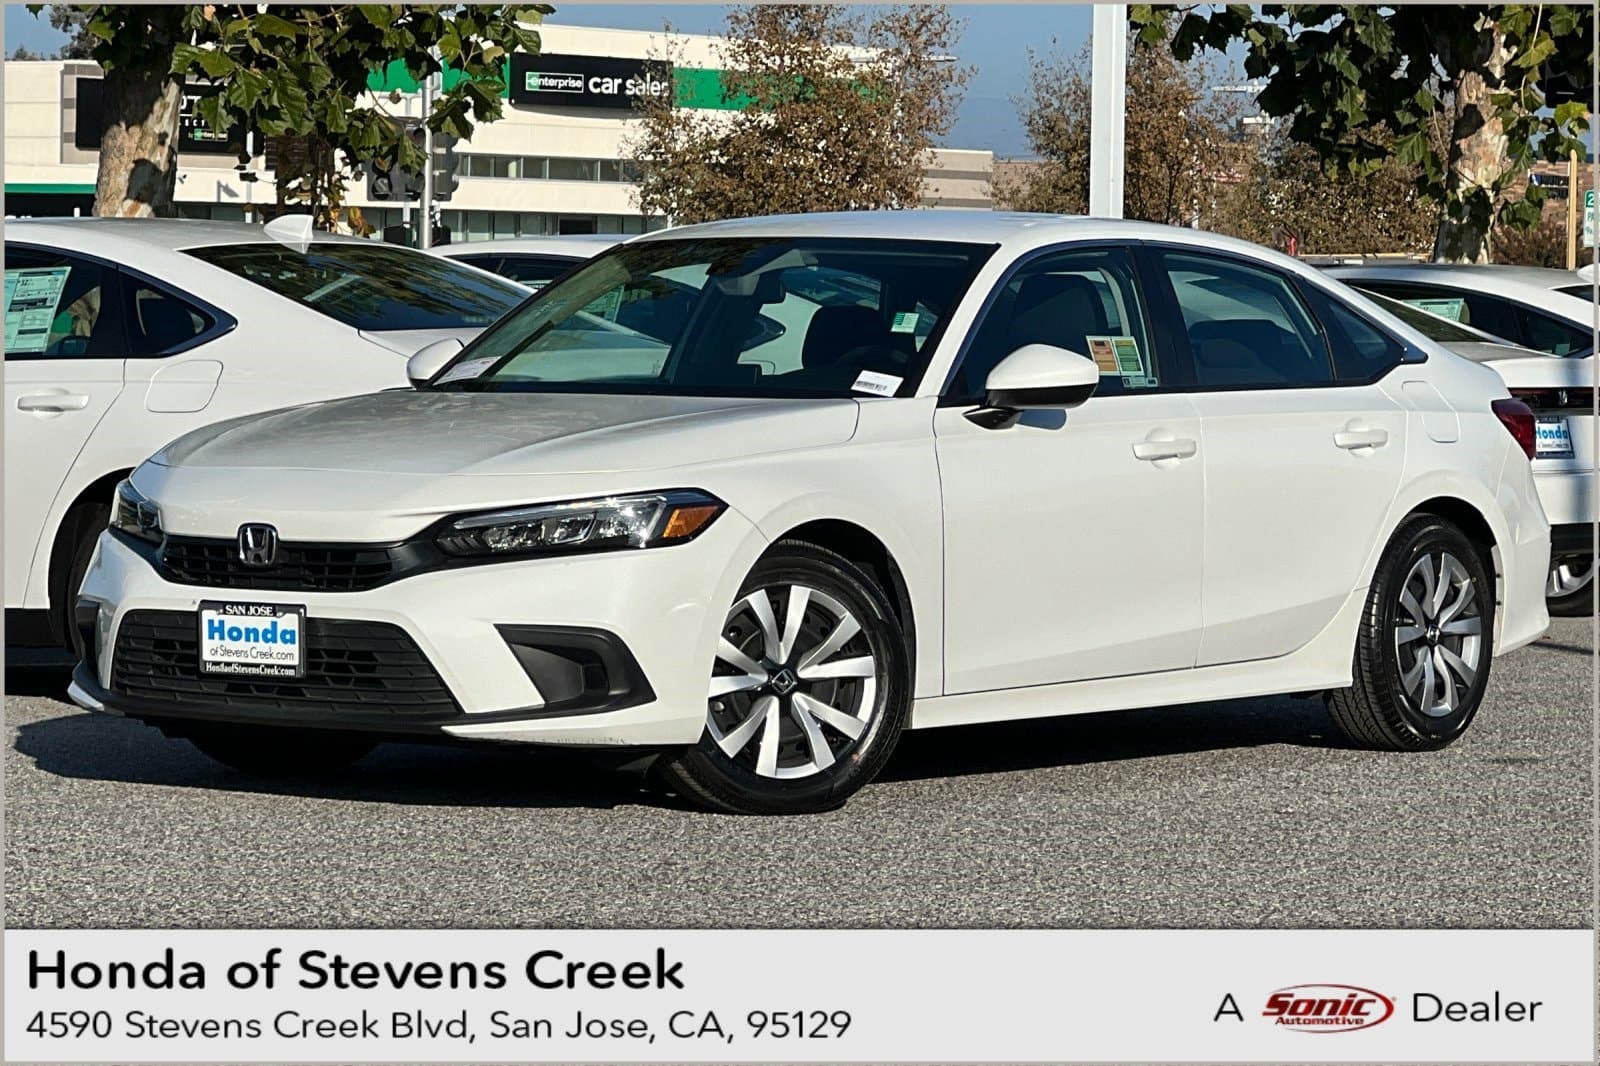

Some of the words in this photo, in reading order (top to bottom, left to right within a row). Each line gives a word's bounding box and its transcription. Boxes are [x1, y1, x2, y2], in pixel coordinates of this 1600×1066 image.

[528, 76, 582, 89] enterprise
[588, 76, 622, 95] car
[225, 605, 246, 616] SAN
[248, 606, 274, 617] JOSE
[207, 618, 296, 645] Honda
